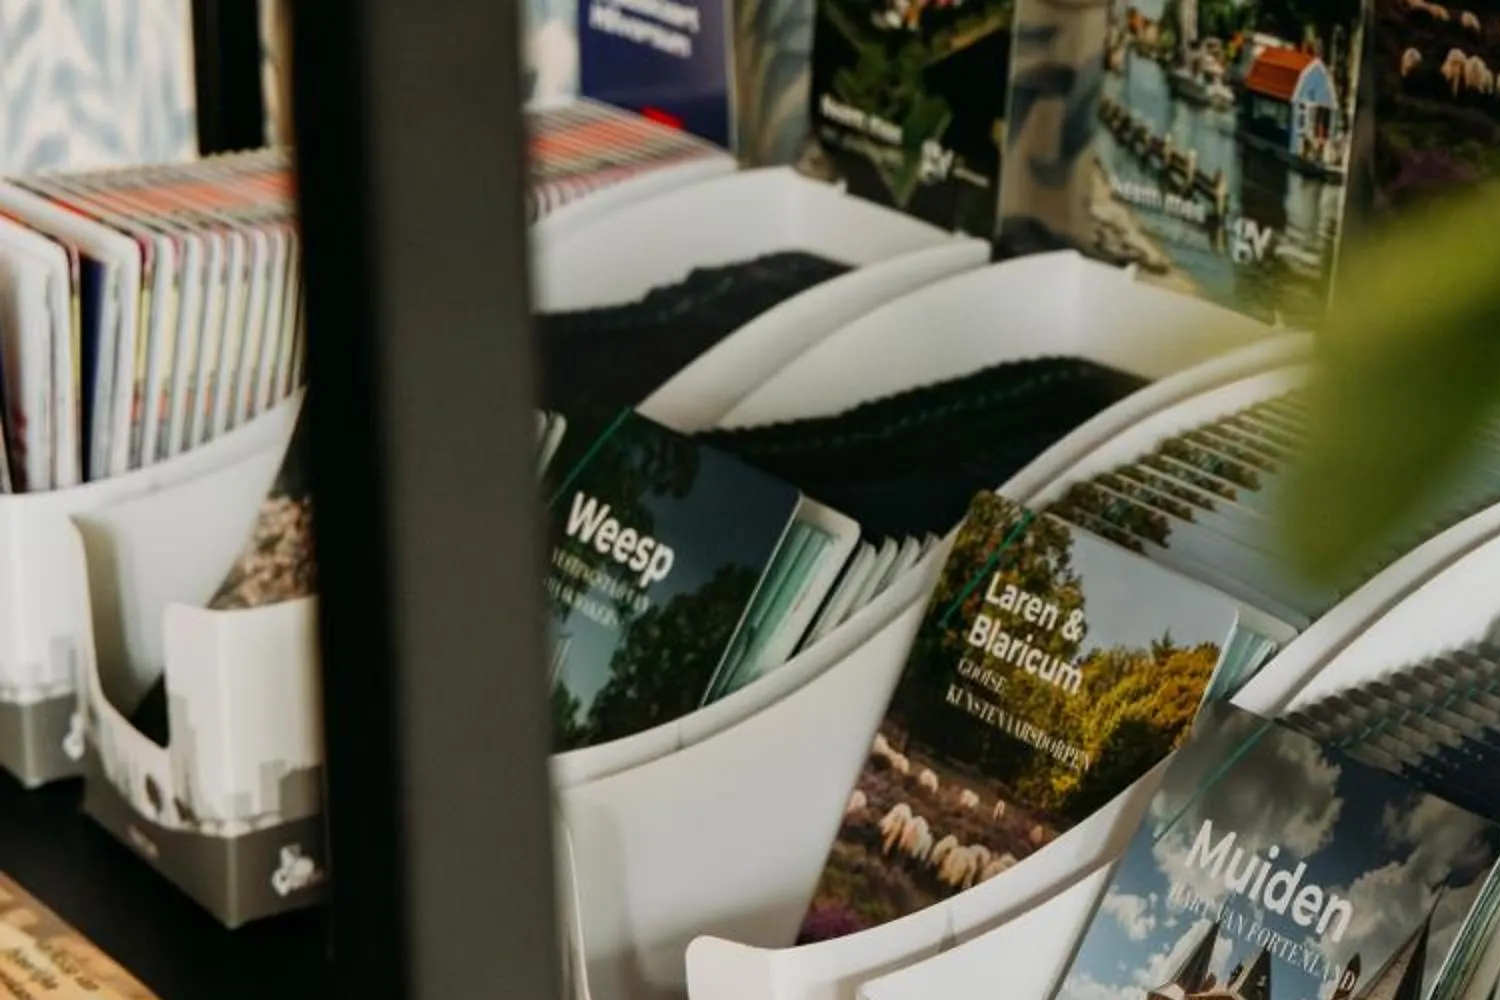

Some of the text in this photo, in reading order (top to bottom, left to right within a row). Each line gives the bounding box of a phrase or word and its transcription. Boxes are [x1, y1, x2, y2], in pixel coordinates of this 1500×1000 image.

[566, 490, 675, 588] Weesp
[984, 571, 1085, 642] Laren &
[967, 613, 1084, 695] Blaricum
[1183, 818, 1355, 944] Muiden
